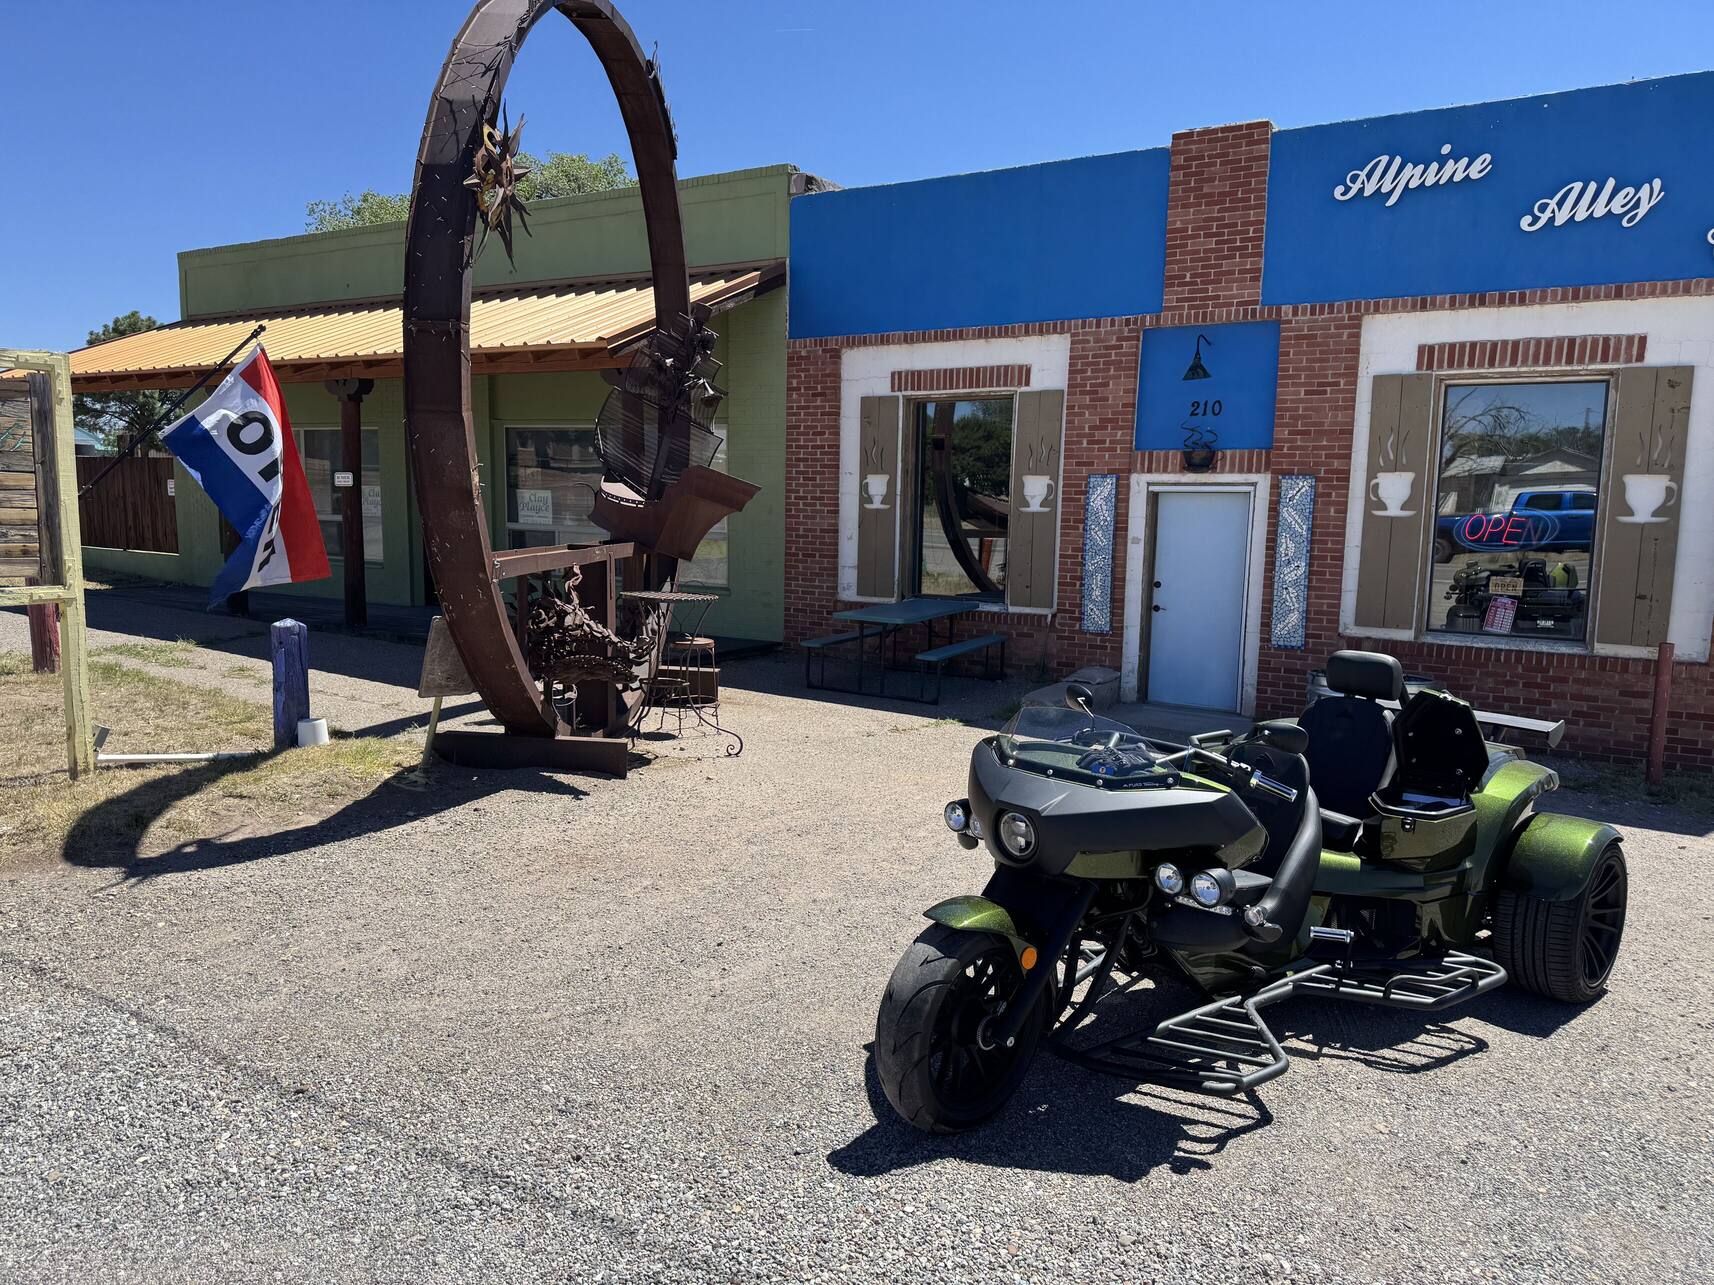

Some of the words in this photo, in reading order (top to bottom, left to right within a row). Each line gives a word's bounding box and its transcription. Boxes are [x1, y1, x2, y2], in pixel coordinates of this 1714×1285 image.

[1334, 143, 1493, 207] Alpine
[1519, 176, 1665, 232] Alley
[1190, 400, 1223, 417] 210
[1465, 514, 1544, 545] OPEN
